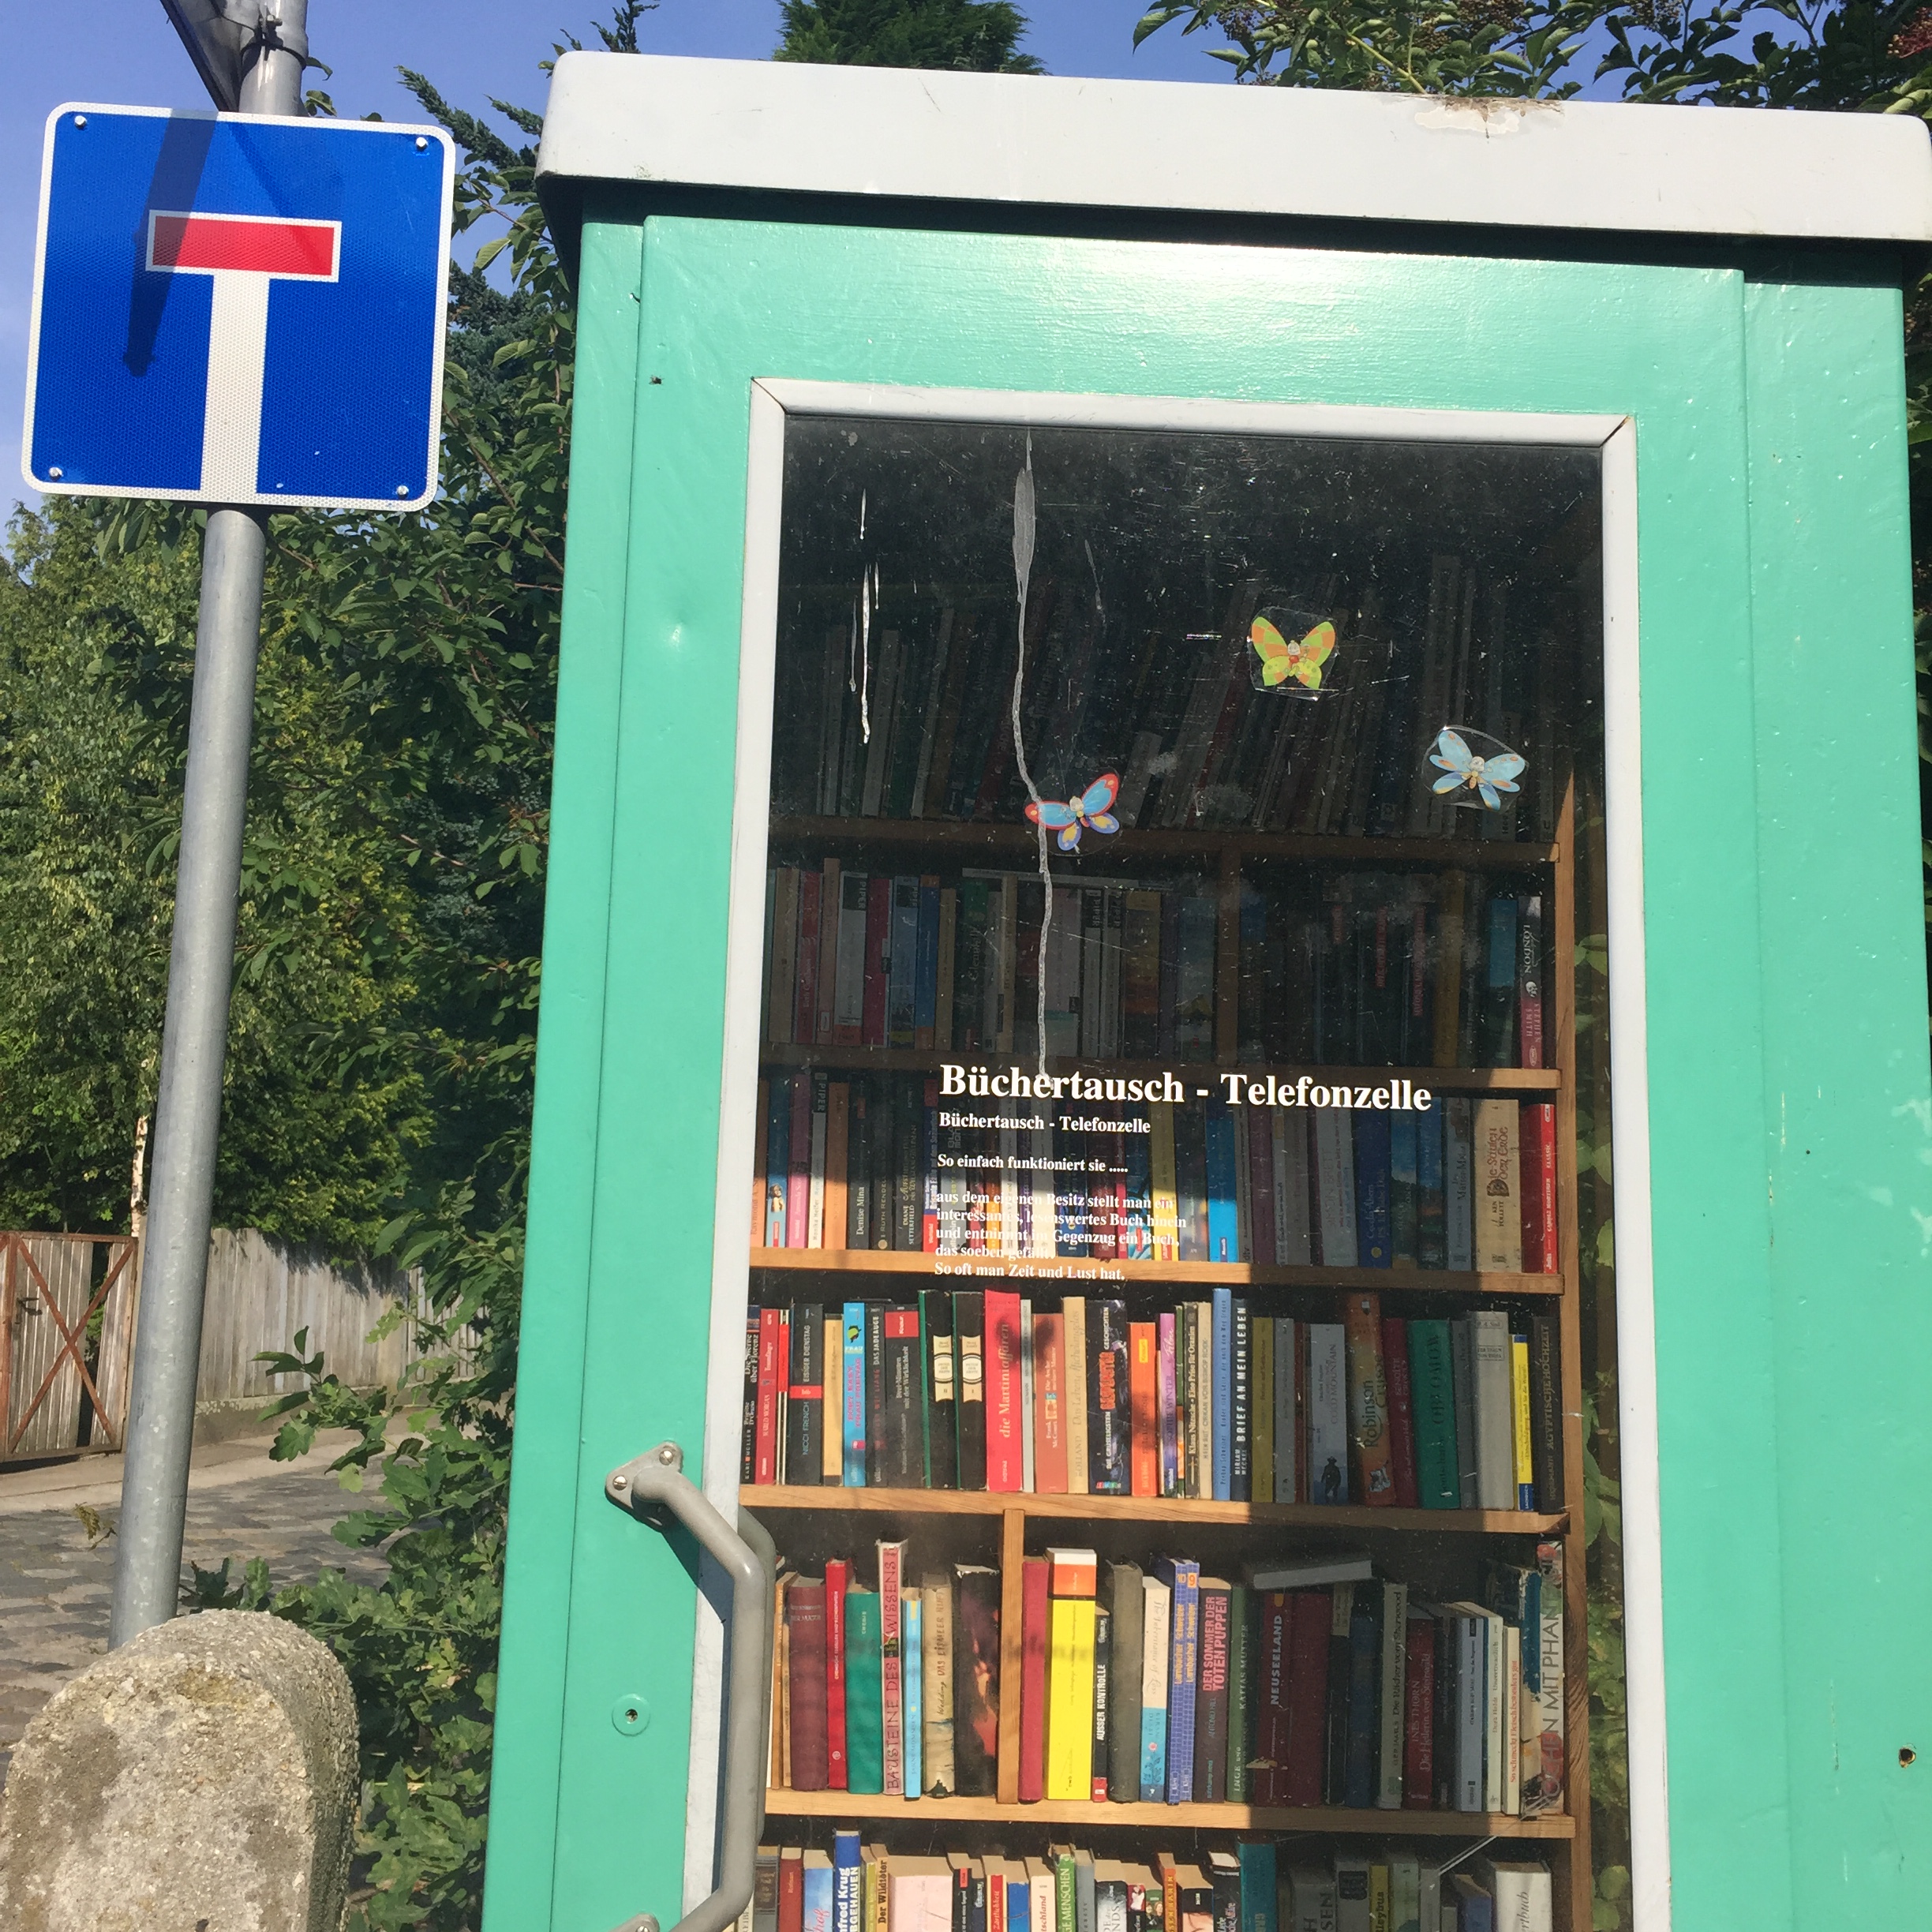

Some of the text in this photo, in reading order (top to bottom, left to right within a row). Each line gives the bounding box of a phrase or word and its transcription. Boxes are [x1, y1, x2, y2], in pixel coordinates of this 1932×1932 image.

[1522, 924, 1532, 973] LONDON
[818, 1083, 826, 1110] PIPER
[939, 1065, 1184, 1103] Büchertausch
[1220, 1073, 1432, 1110] Telefonzelle
[939, 1112, 1044, 1130] Büchertausch
[1059, 1115, 1151, 1133] Telefonzelle
[938, 1154, 1106, 1172] So einfach funktioniert sie
[936, 1191, 1174, 1209] aus dem eigenen Besitz stellt man ein
[937, 1208, 1187, 1228] interessantes, lesenswertes Buch hinein
[935, 1244, 1056, 1262] das soeben gefällt.
[936, 1226, 960, 1239] und
[1032, 1228, 1049, 1241] im
[1052, 1229, 1116, 1247] Gegenzug
[1118, 1233, 1138, 1245] ein
[1142, 1233, 1180, 1247] Buch,
[934, 1262, 1125, 1280] So oft man Zeit und Lust hat.
[1236, 1307, 1247, 1442] BRIEF AN MEIN LEBEN
[1538, 1324, 1552, 1379] HOCHZEIT
[998, 1324, 1013, 1437] die Martiniaffären
[1165, 1376, 1174, 1409] WINTER
[1329, 1344, 1339, 1424] COLD MOUNTAIN
[1374, 1355, 1387, 1408] Crusoe
[1426, 1334, 1446, 1425] OBLOMOW
[1362, 1380, 1382, 1448] Robinson
[1541, 1380, 1555, 1451] ÄGYPTISCHE
[934, 1617, 946, 1657] EISMEER
[1202, 1597, 1215, 1690] DER SOMMER DER
[1213, 1597, 1227, 1691] TOTEN PUPPEN
[1270, 1615, 1283, 1705] NEUSEELAND
[884, 1561, 899, 1788] BAUSTEINE DES WISSENS
[1174, 1644, 1183, 1684] Lambacher
[1185, 1642, 1194, 1683] Lambacher
[936, 1681, 946, 1715] Wedding
[1096, 1664, 1106, 1740] AUSSER KONTROLLE
[1411, 1681, 1420, 1717] THORN
[1542, 1674, 1559, 1710] MIT
[1510, 1661, 1519, 1783] So schmeckt Fleisch besonders gut
[1420, 1755, 1430, 1772] Die
[837, 1868, 850, 1899] Krug
[850, 1866, 859, 1932] BGEHAUEN
[877, 1859, 888, 1923] Der Wildtöter
[1060, 1868, 1072, 1920] MENSCHEN
